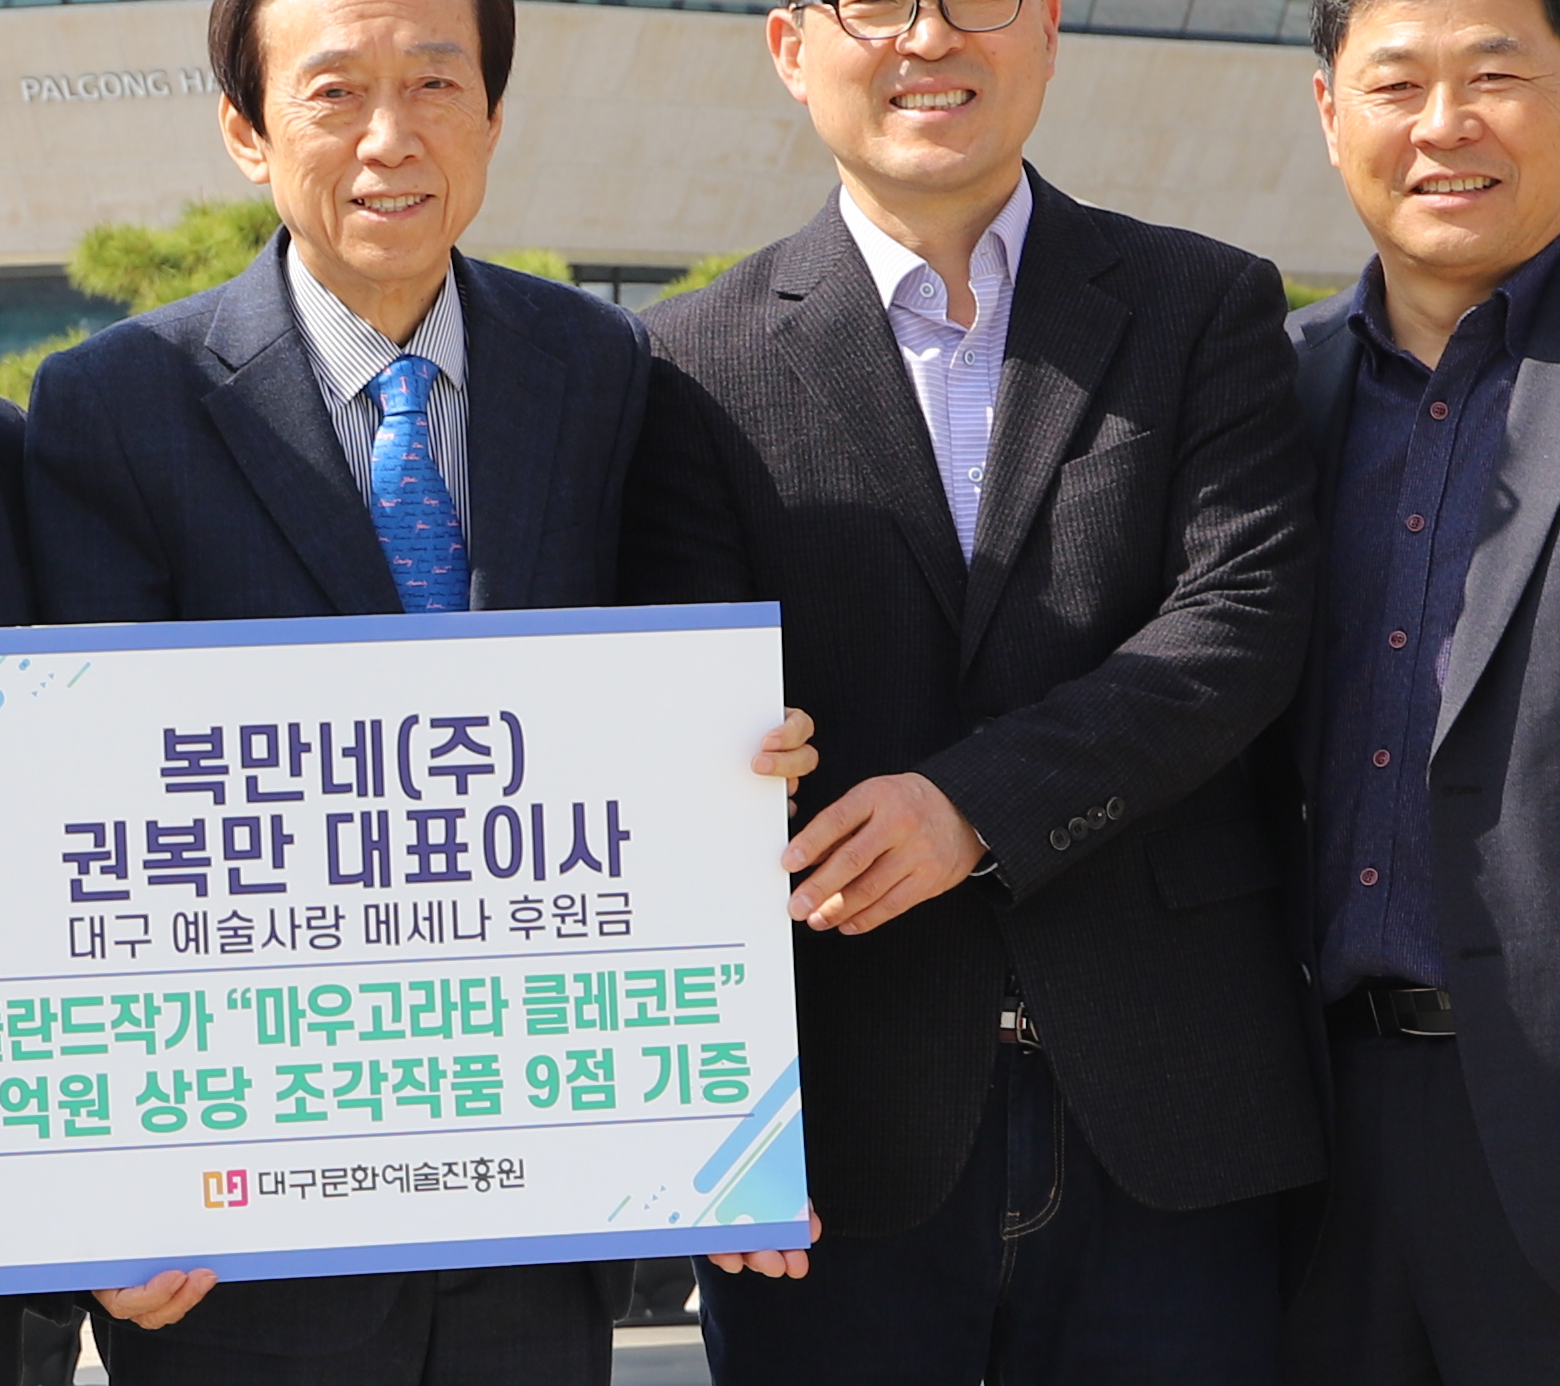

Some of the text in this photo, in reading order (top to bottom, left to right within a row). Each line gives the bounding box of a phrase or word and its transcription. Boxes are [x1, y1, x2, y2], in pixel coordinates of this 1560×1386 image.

[21, 70, 170, 103] PALGONG
[160, 710, 525, 806] 복만네(주)
[62, 800, 631, 903] 권복만 대표이사
[69, 892, 632, 959] 대구 예술사랑 메세나 후원금
[227, 976, 509, 1047] “마우고라타
[522, 963, 745, 1035] 클레코트”
[136, 1066, 252, 1133] 상당
[275, 1054, 504, 1123] 조각작품
[526, 1048, 616, 1111] 9점
[642, 1042, 750, 1104] 기증
[258, 1157, 524, 1199] 대구문화예술진흥원
